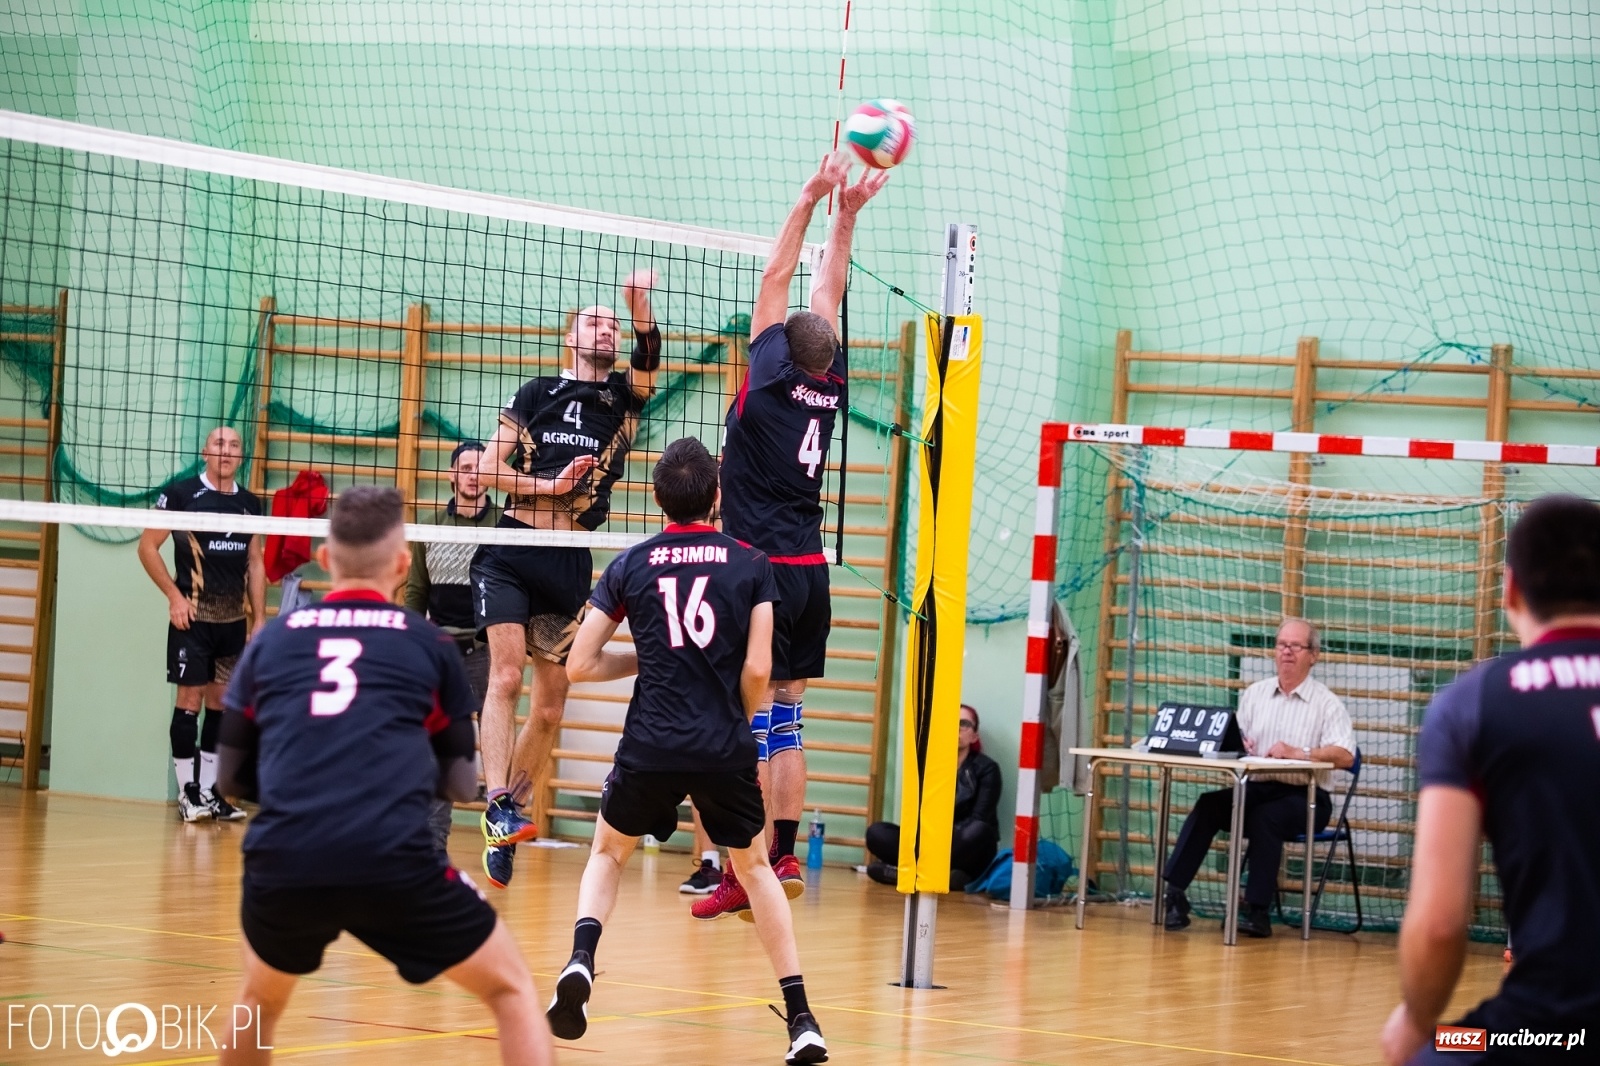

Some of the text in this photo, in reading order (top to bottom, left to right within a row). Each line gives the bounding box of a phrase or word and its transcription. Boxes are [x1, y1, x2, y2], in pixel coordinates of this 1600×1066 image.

[563, 400, 583, 430] 4
[797, 417, 822, 478] 4
[286, 608, 408, 630] #DANIEL
[657, 575, 716, 649] 16
[179, 662, 187, 678] 7
[310, 638, 363, 716] 3
[1155, 707, 1229, 736] 15 0 0 19
